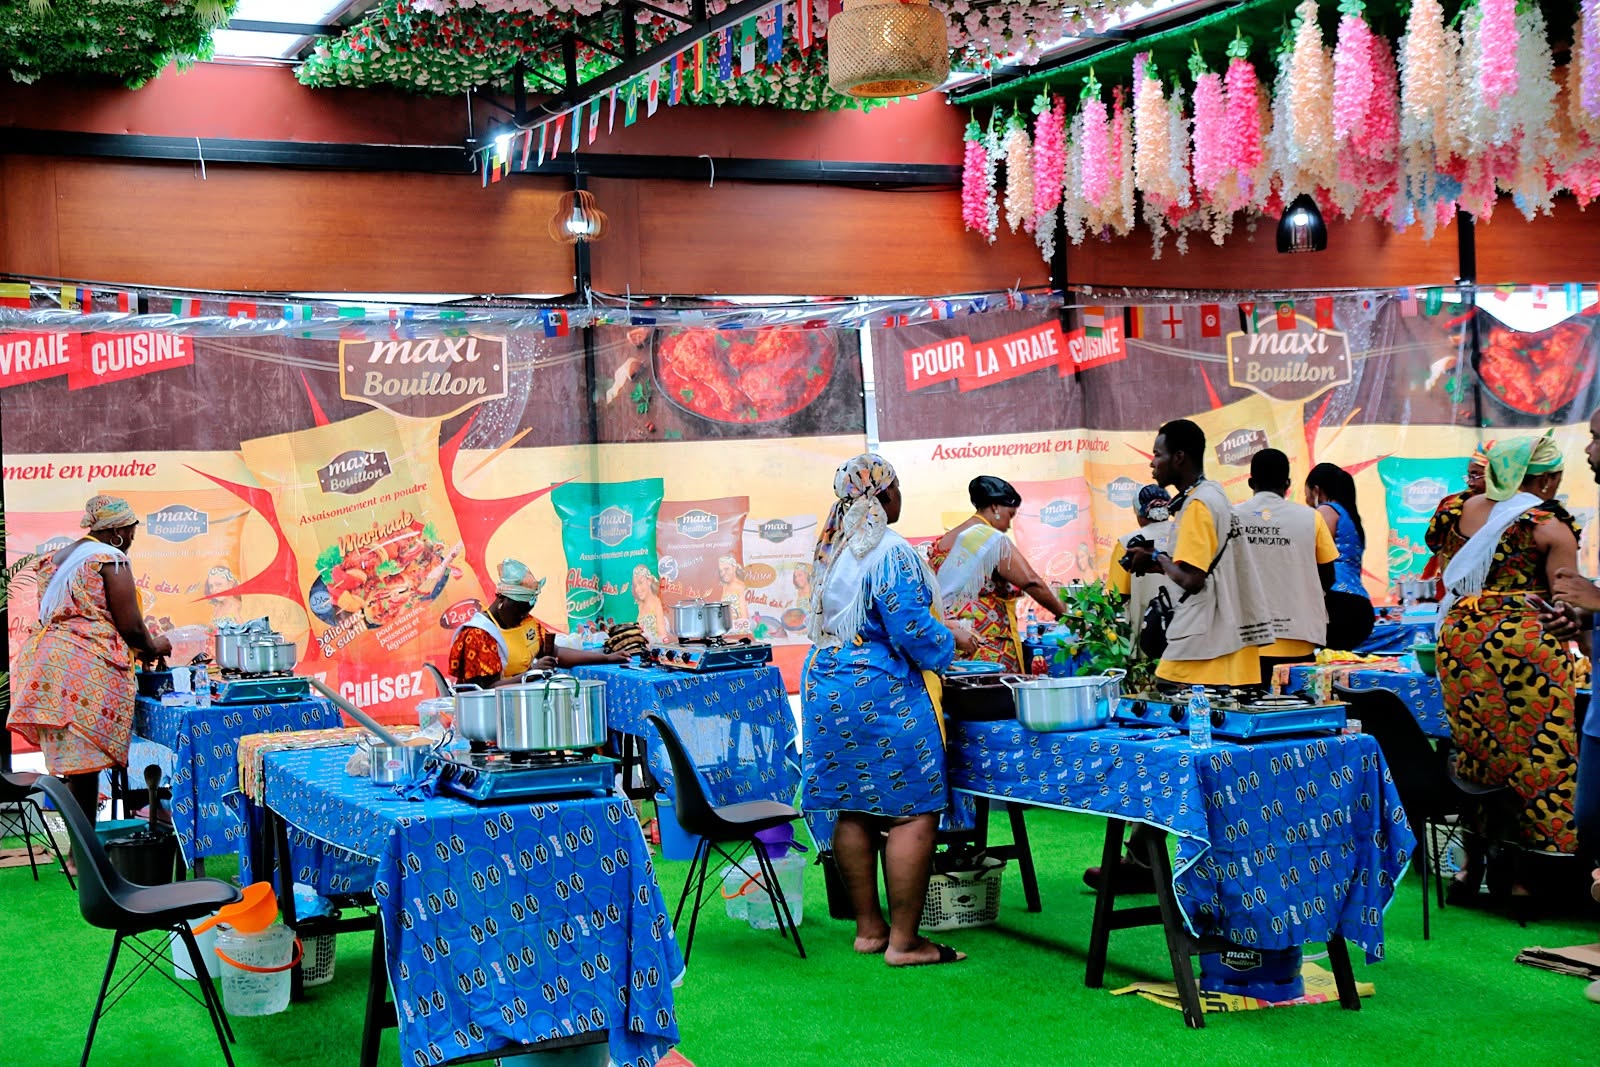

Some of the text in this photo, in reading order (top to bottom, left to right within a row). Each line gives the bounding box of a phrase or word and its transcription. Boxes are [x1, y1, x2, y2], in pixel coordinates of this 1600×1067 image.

[0, 332, 186, 375] VRAIE CUISINE
[367, 337, 481, 364] maxi
[911, 327, 1120, 380] POUR LA VRAIE CUISINE
[1247, 329, 1329, 355] maxi
[363, 371, 487, 396] Bouillon
[1246, 360, 1337, 384] Bouillon
[931, 436, 1110, 461] Assaisonnement en poudre
[1223, 430, 1259, 451] maxi
[59, 465, 84, 479] en
[87, 459, 157, 482] poudre
[328, 449, 378, 477] maxi
[330, 467, 384, 491] Bouillon
[156, 509, 199, 522] maxi
[299, 483, 428, 526] Assaisonnement en poudre
[1045, 502, 1072, 514] maxi
[154, 524, 201, 535] Bouillon
[682, 513, 711, 524] maxi
[1245, 526, 1281, 535] AGENCE DE
[338, 509, 413, 557] Marinade
[566, 568, 600, 594] Akadi
[316, 608, 365, 650] Délicieux
[325, 622, 367, 658] & subtil
[375, 622, 395, 639] pour
[379, 616, 420, 648] poissons et
[1226, 951, 1254, 959] maxi
